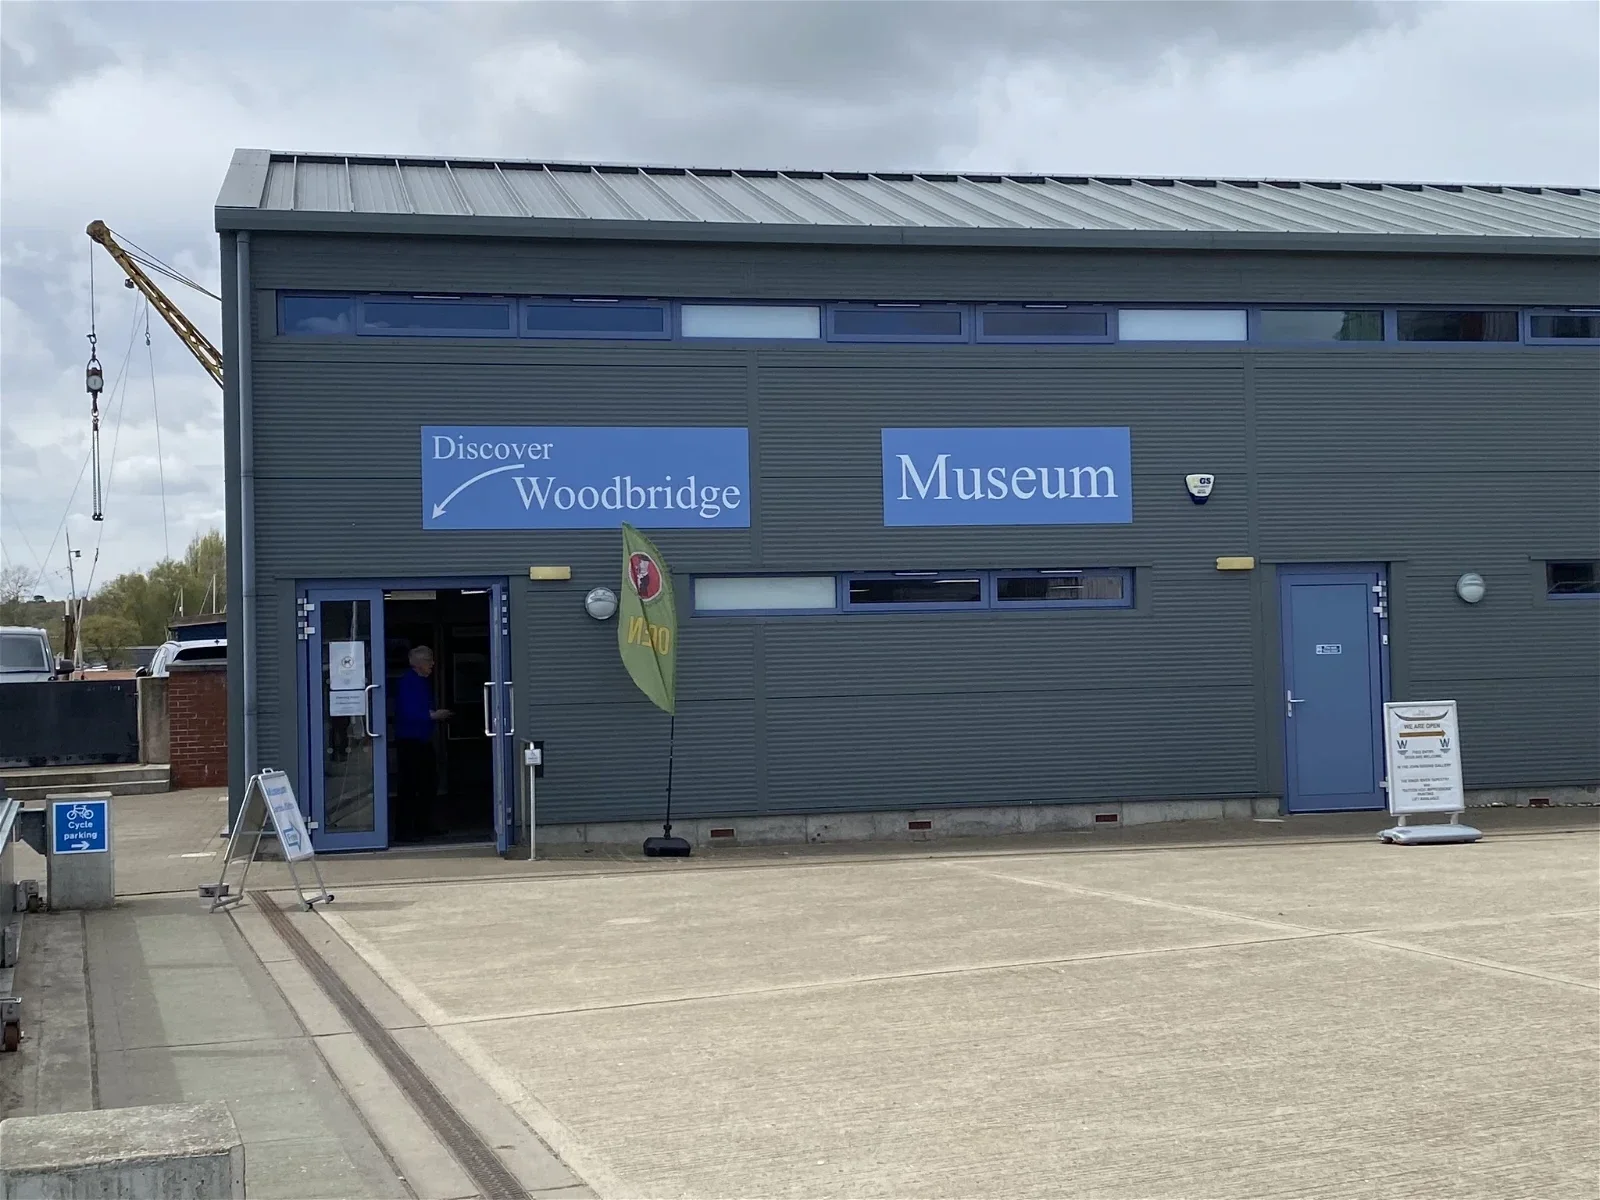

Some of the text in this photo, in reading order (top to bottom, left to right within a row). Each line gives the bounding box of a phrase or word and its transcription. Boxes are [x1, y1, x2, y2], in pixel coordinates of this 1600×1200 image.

[432, 435, 554, 460] Discover
[896, 453, 1119, 500] Museum
[512, 475, 741, 518] Woodbridge
[63, 831, 98, 841] parking
[68, 820, 93, 830] Cycle
